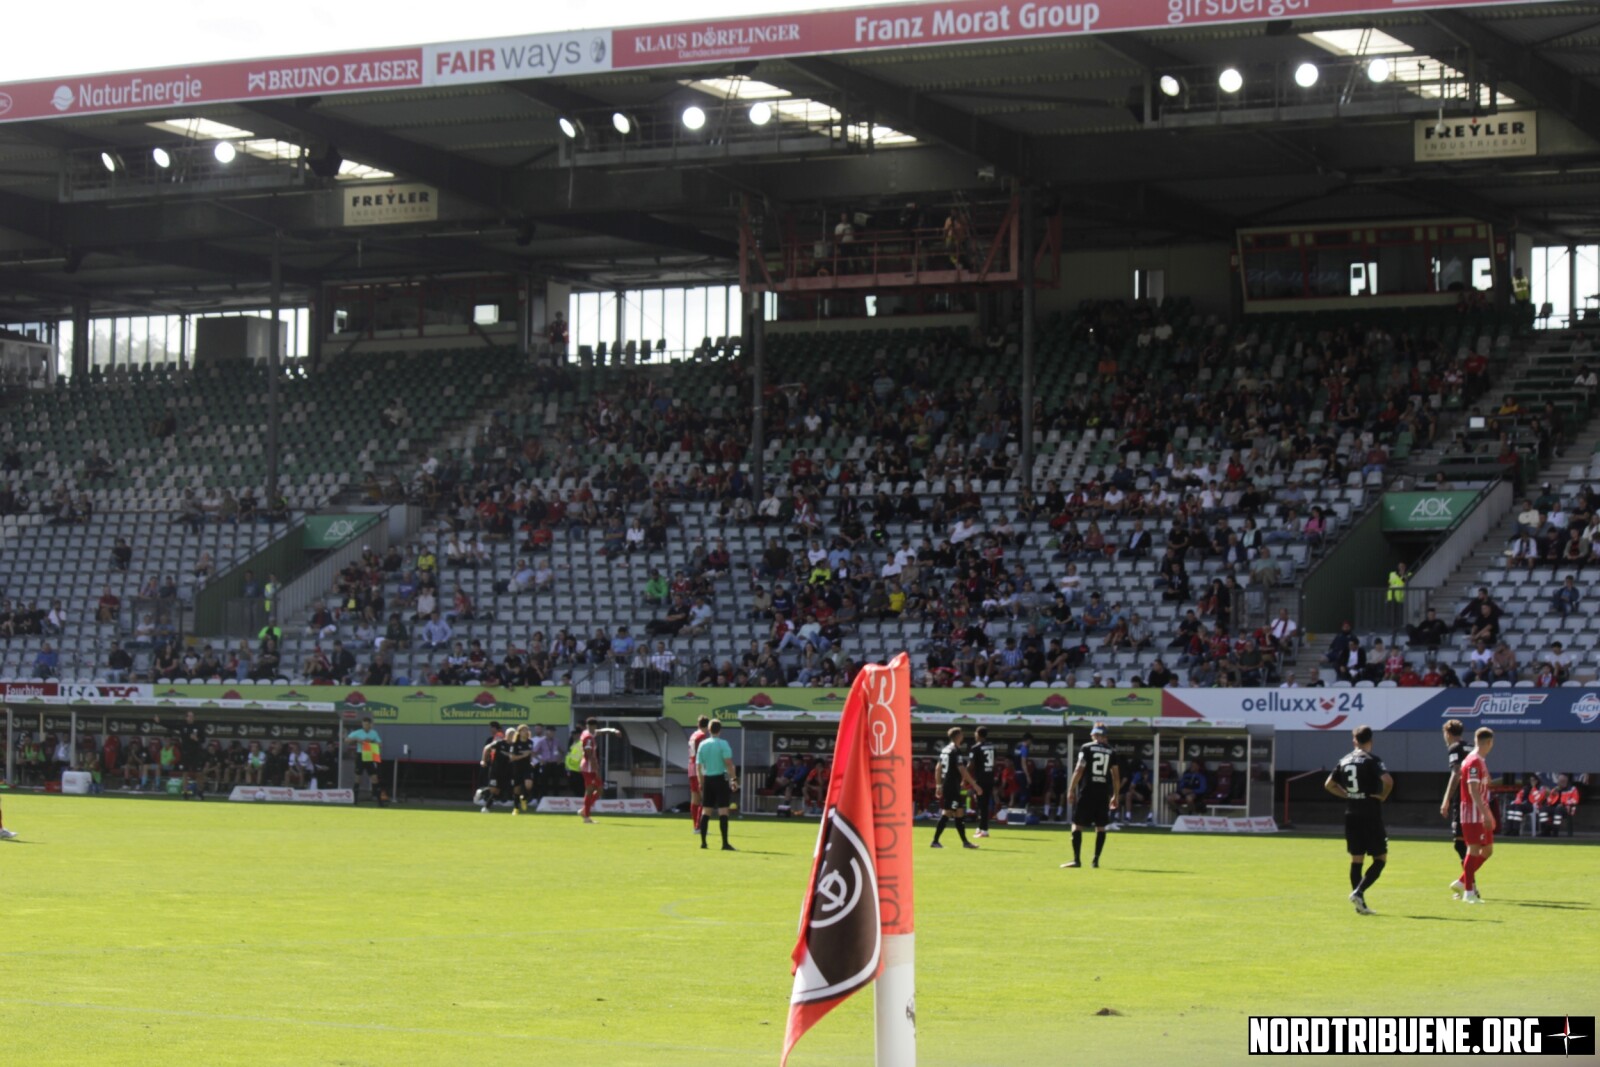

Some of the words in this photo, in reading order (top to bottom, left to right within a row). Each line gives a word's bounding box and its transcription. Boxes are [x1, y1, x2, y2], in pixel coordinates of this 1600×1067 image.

[855, 16, 924, 42] Franz
[932, 6, 1010, 36] Morat
[1019, 2, 1100, 31] Group
[634, 32, 688, 53] KLAUS
[692, 24, 800, 48] DÖRFLINGER
[268, 64, 340, 90] BRUNO
[343, 58, 419, 84] KAISER
[79, 74, 202, 108] NaturEnergie
[1425, 121, 1525, 139] FREYLER
[352, 192, 430, 207] FREYLER
[1410, 497, 1452, 516] AOK
[323, 519, 358, 536] AOK
[1242, 692, 1316, 713] oelluxx
[1339, 692, 1364, 712] 24
[1092, 752, 1110, 776] 21
[1344, 764, 1359, 793] 3
